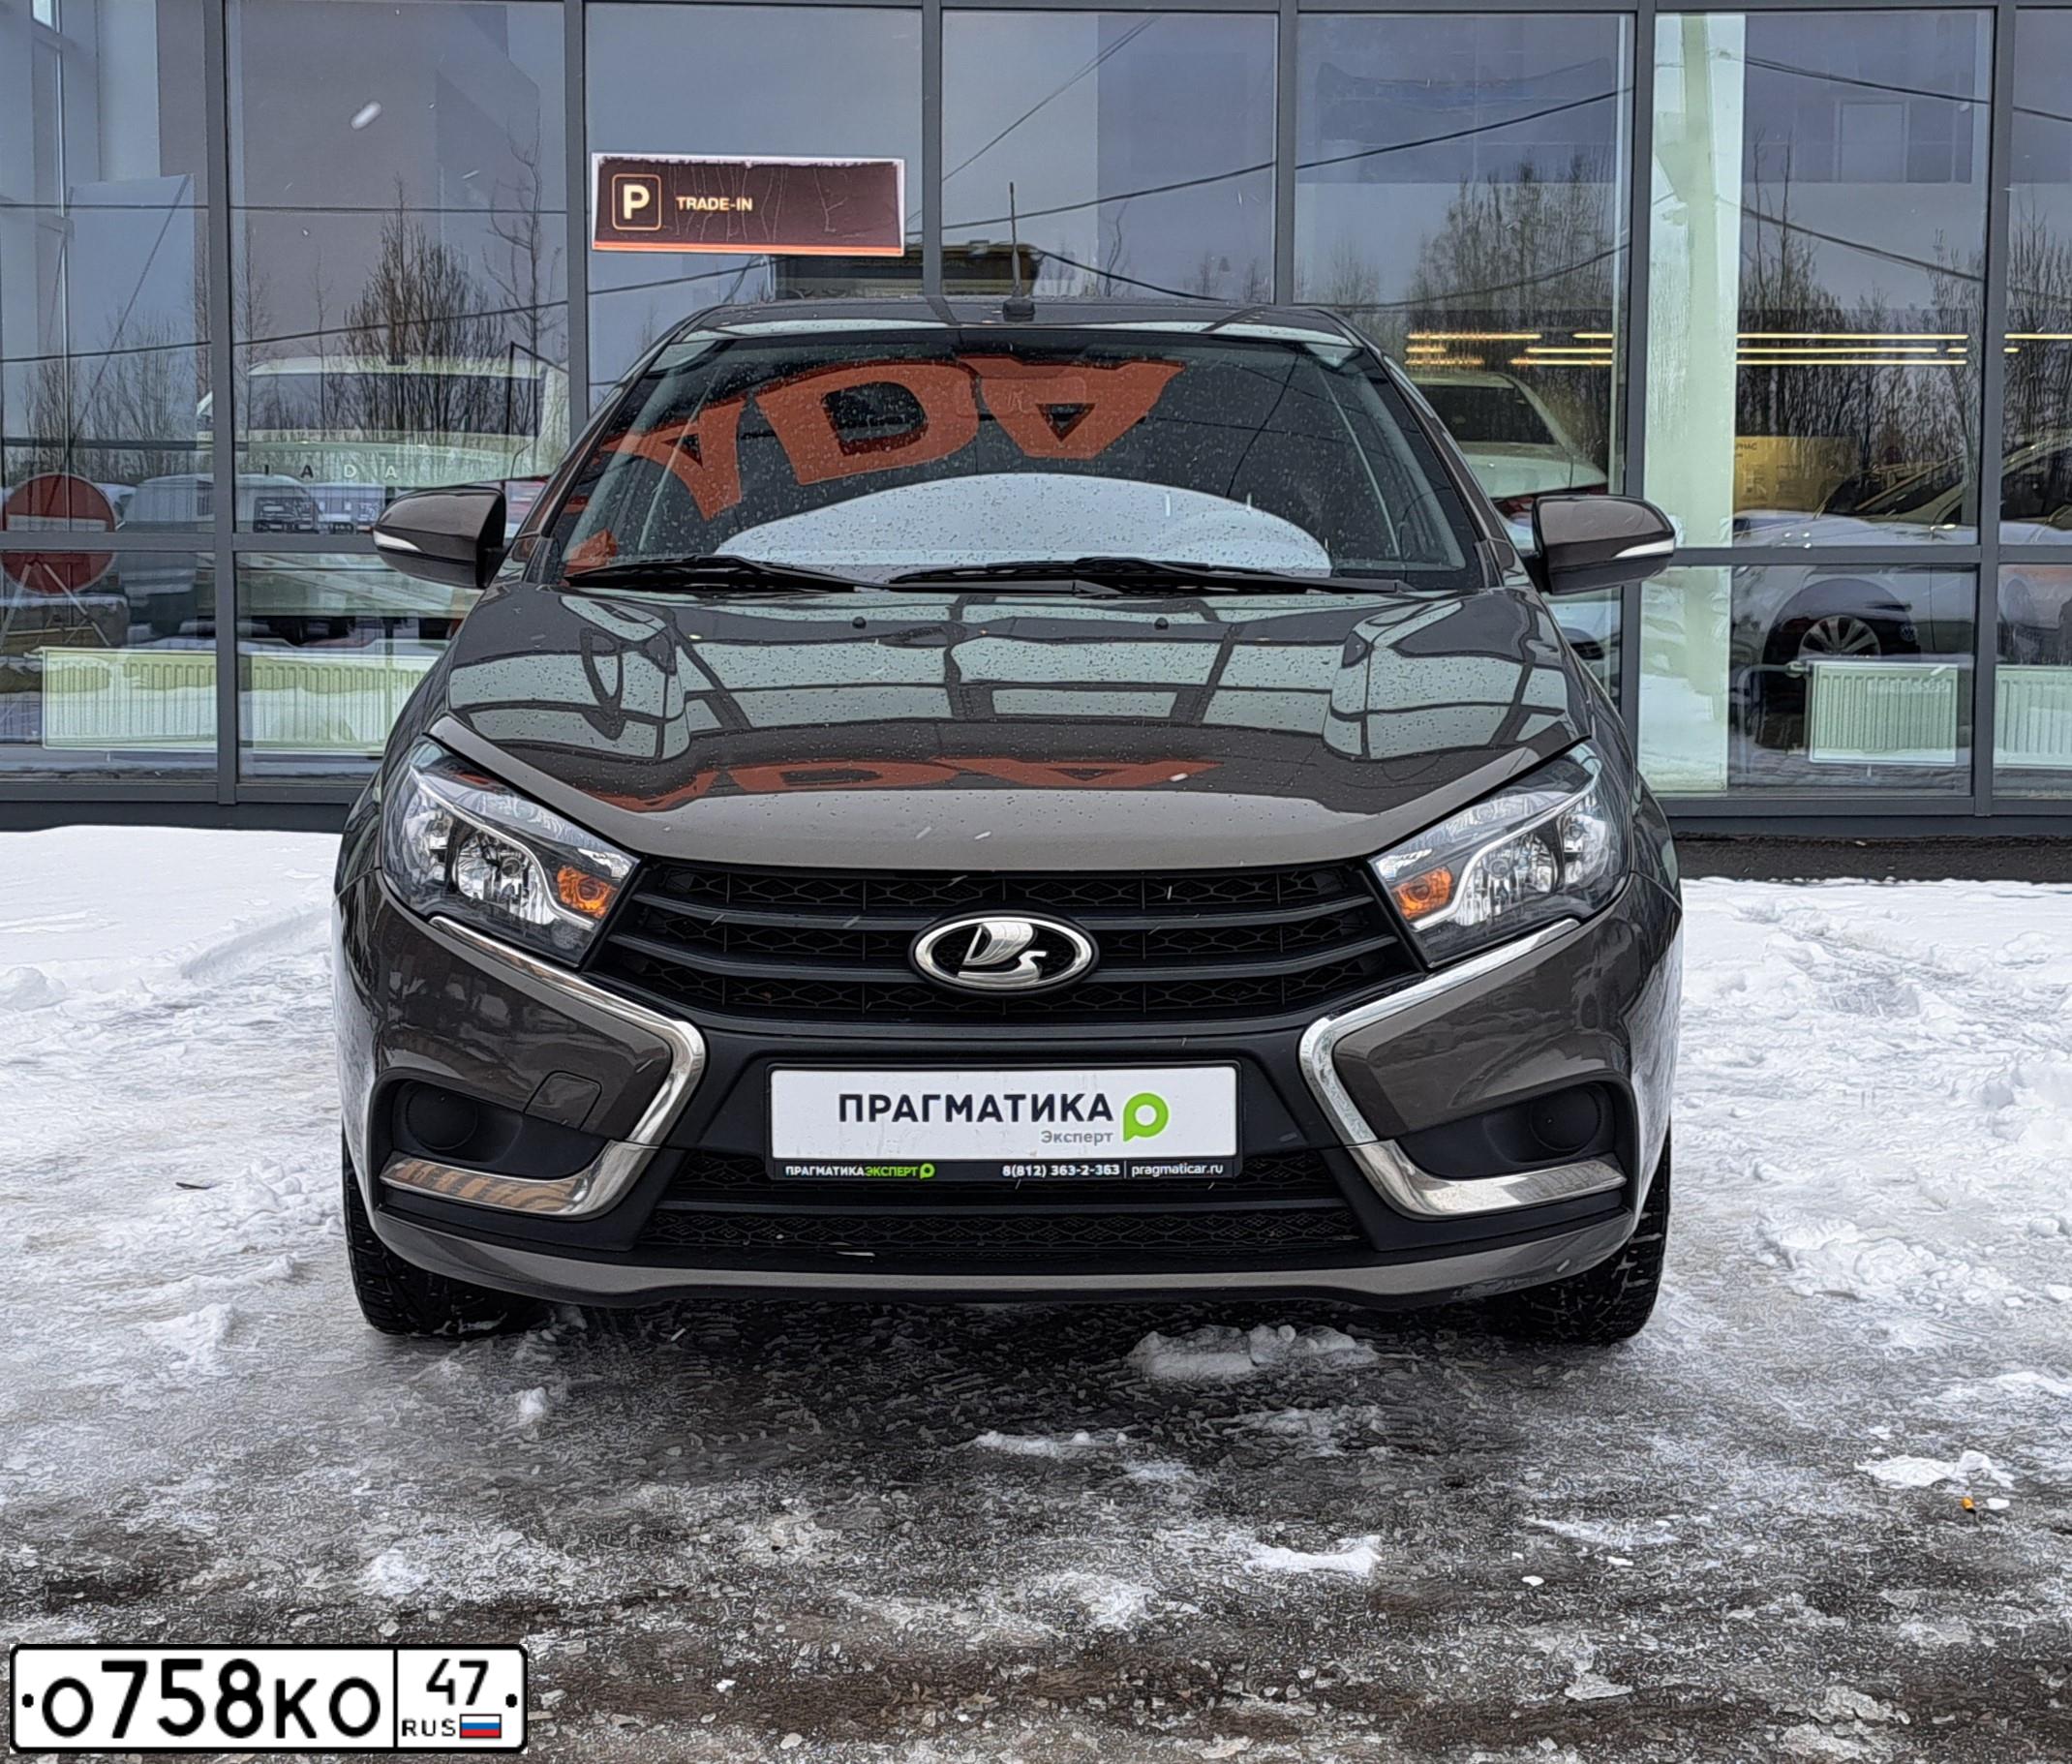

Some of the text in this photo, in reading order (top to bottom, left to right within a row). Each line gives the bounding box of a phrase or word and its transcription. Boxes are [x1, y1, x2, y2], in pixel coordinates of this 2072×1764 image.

[623, 184, 753, 220] P TRADE-IN
[838, 1093, 1114, 1123] ПРАГМАТИКА
[1041, 1130, 1114, 1147] Эксперт
[1001, 1164, 1121, 1178] 8(812) 363-2-363
[1131, 1163, 1224, 1178] pragmaticar.ru
